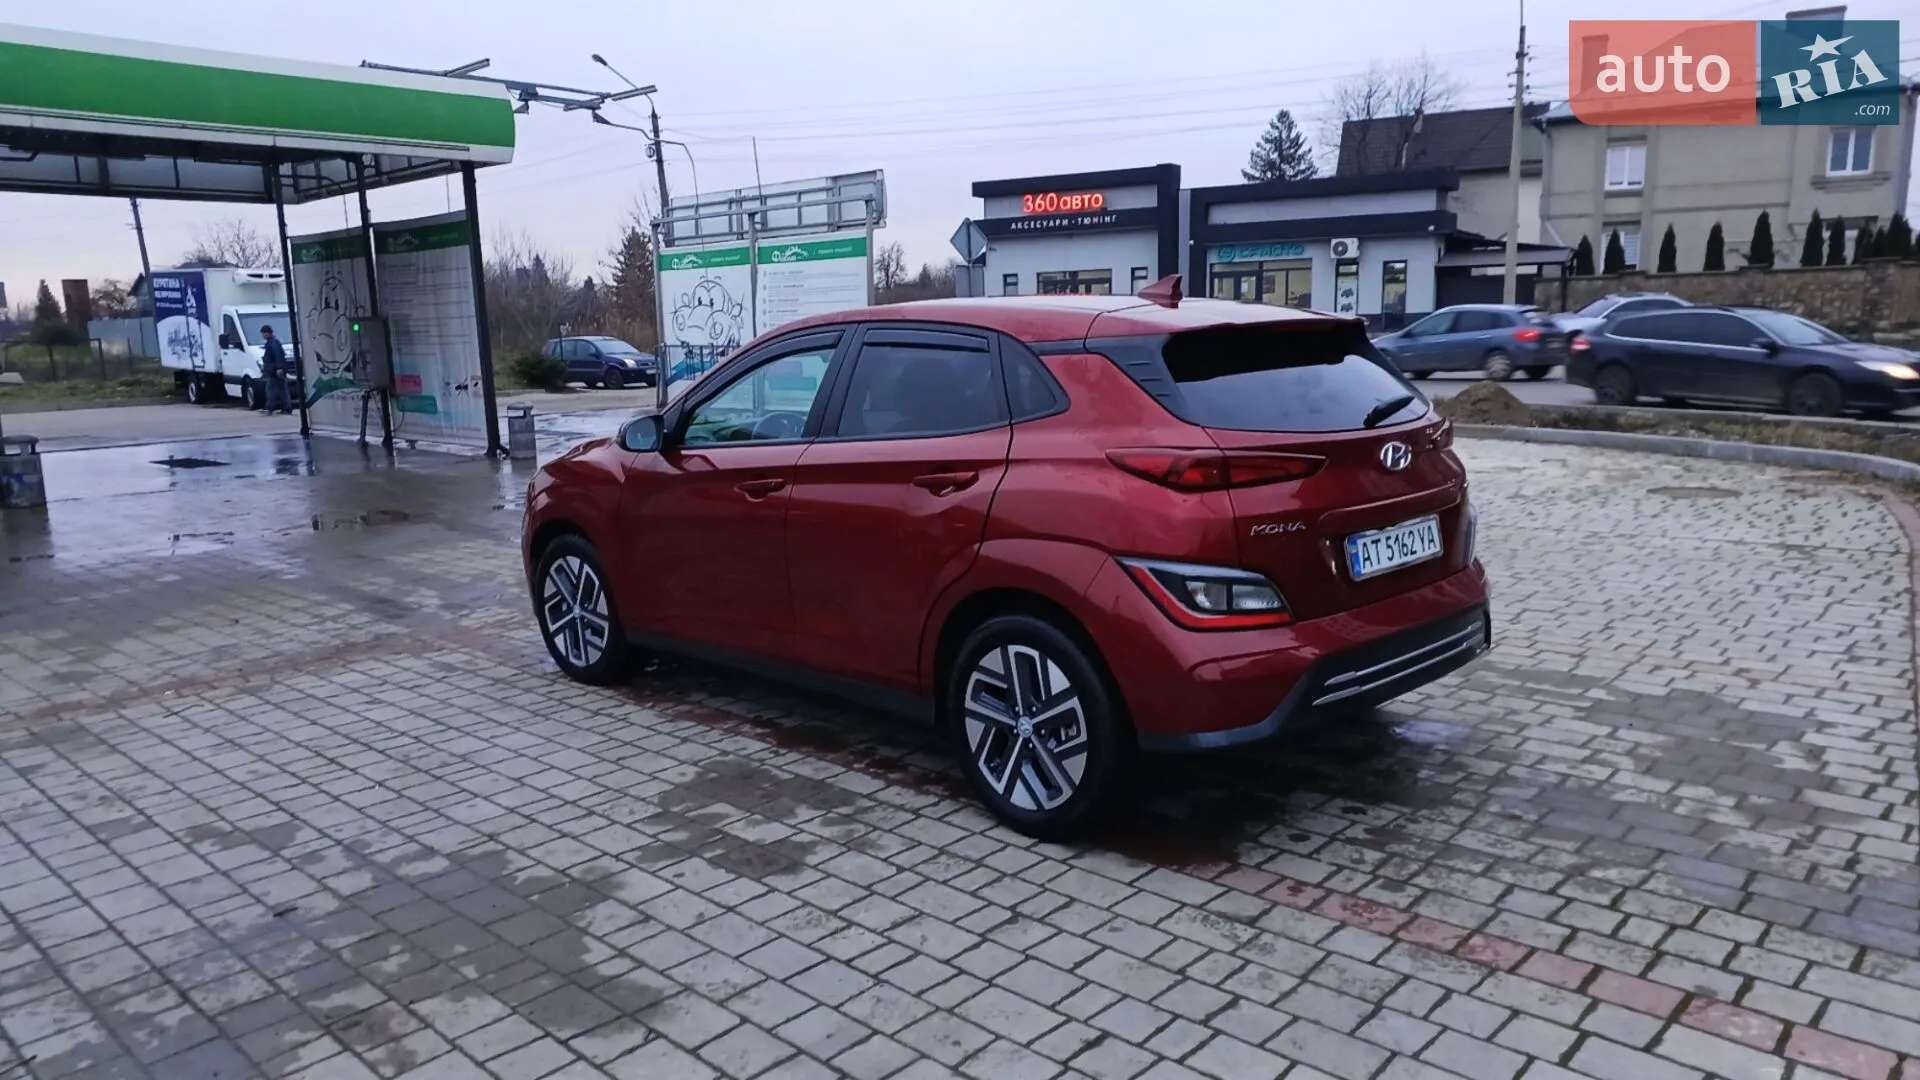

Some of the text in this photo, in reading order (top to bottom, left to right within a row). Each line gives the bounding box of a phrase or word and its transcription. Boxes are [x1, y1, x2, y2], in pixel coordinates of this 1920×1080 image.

[1010, 214, 1117, 230] АКСЕСУАРИ ТЮНІНГ
[1250, 521, 1307, 537] KONA
[1362, 525, 1437, 569] AT 5162 YA
